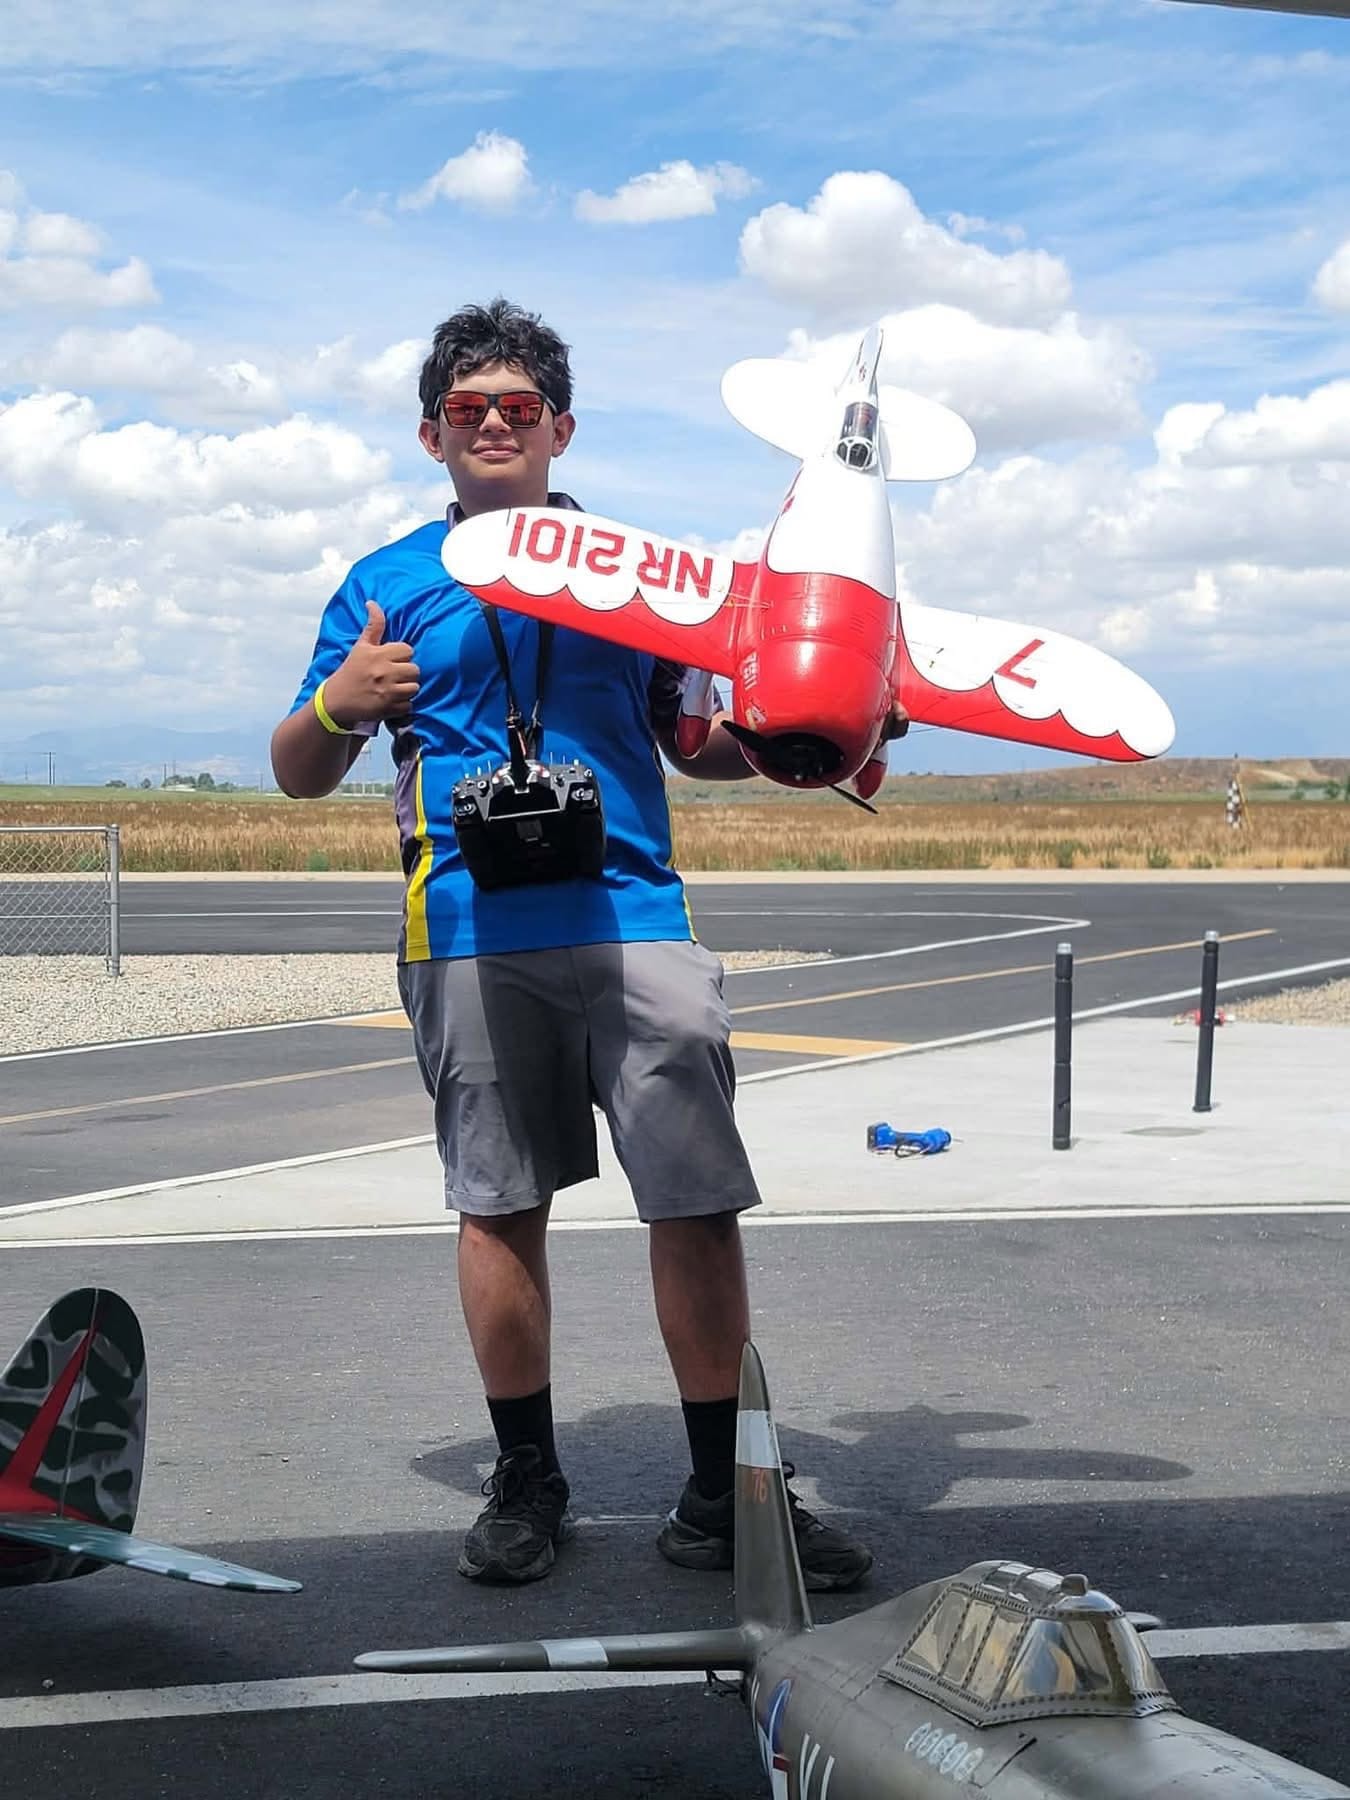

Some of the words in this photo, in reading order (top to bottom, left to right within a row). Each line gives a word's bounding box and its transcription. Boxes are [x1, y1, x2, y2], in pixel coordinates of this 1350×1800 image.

[508, 513, 625, 576] 2101
[636, 541, 713, 599] NR
[995, 639, 1044, 689] 7
